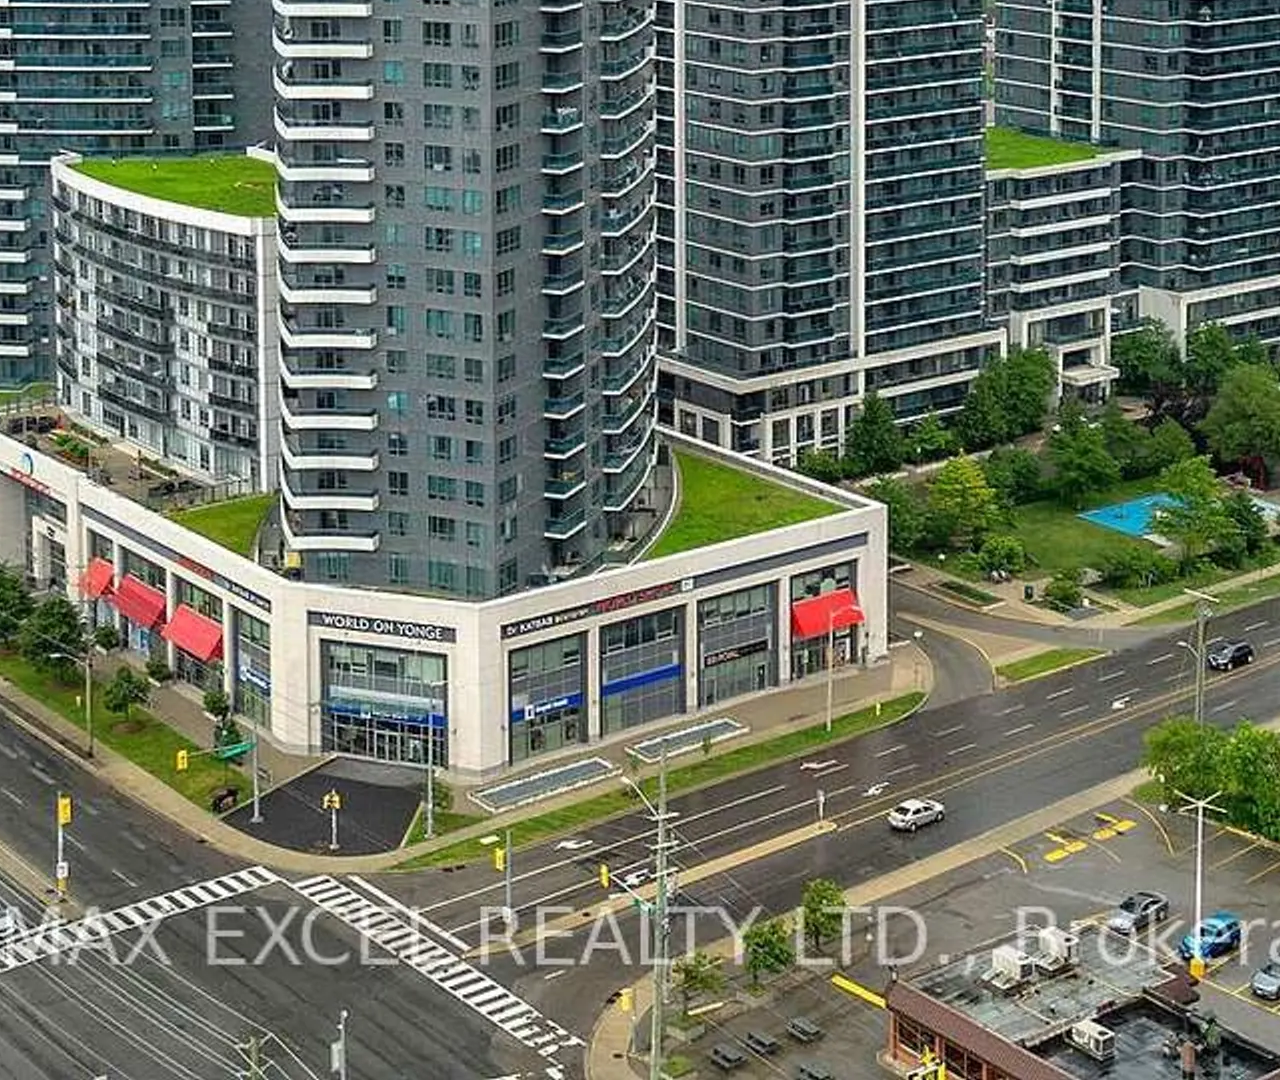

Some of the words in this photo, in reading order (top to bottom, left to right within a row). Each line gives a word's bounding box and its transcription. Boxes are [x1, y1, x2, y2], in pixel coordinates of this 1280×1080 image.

[322, 613, 369, 630] WORLD
[373, 619, 393, 634] ON
[396, 622, 444, 640] YONGE
